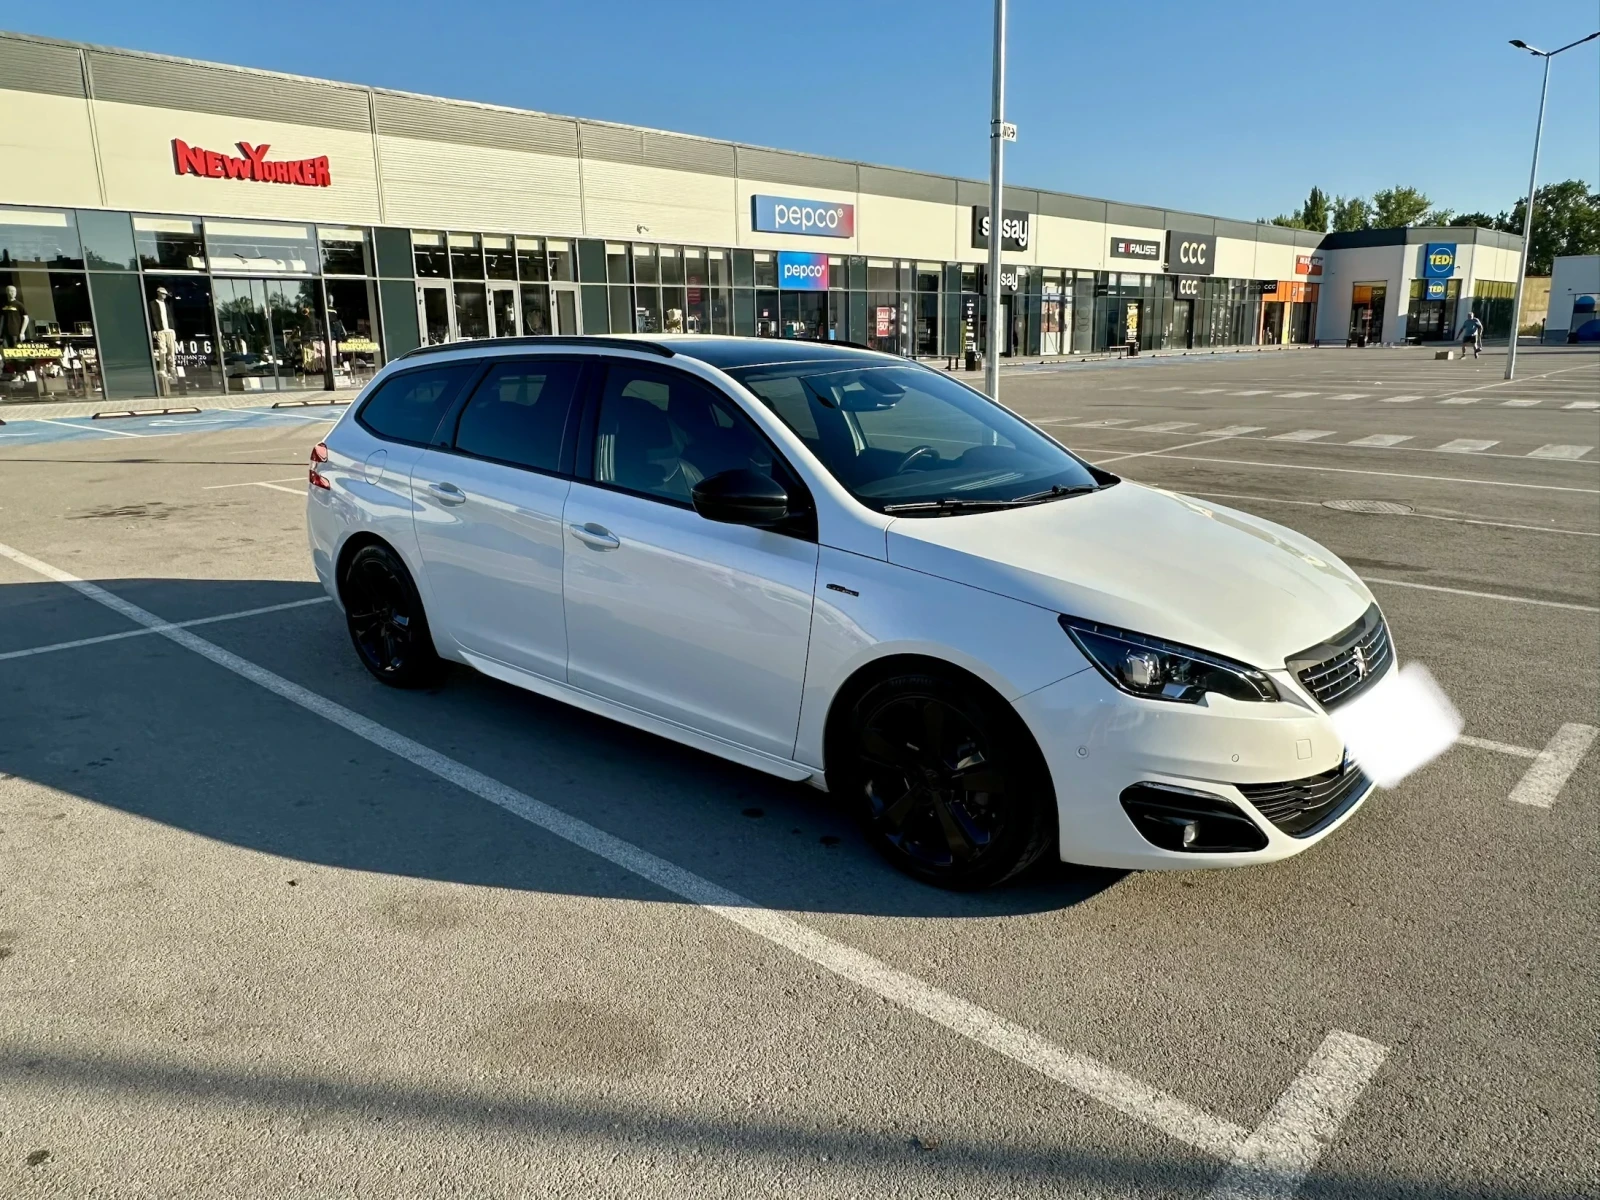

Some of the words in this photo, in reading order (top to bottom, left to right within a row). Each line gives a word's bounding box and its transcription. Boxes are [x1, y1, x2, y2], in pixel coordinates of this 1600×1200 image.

[775, 204, 838, 231] pepco
[982, 216, 1028, 247] ssay
[1180, 241, 1207, 265] CCC
[784, 263, 822, 280] pepco
[1000, 272, 1018, 291] say
[1180, 280, 1198, 295] CCC
[174, 340, 212, 354] MOG
